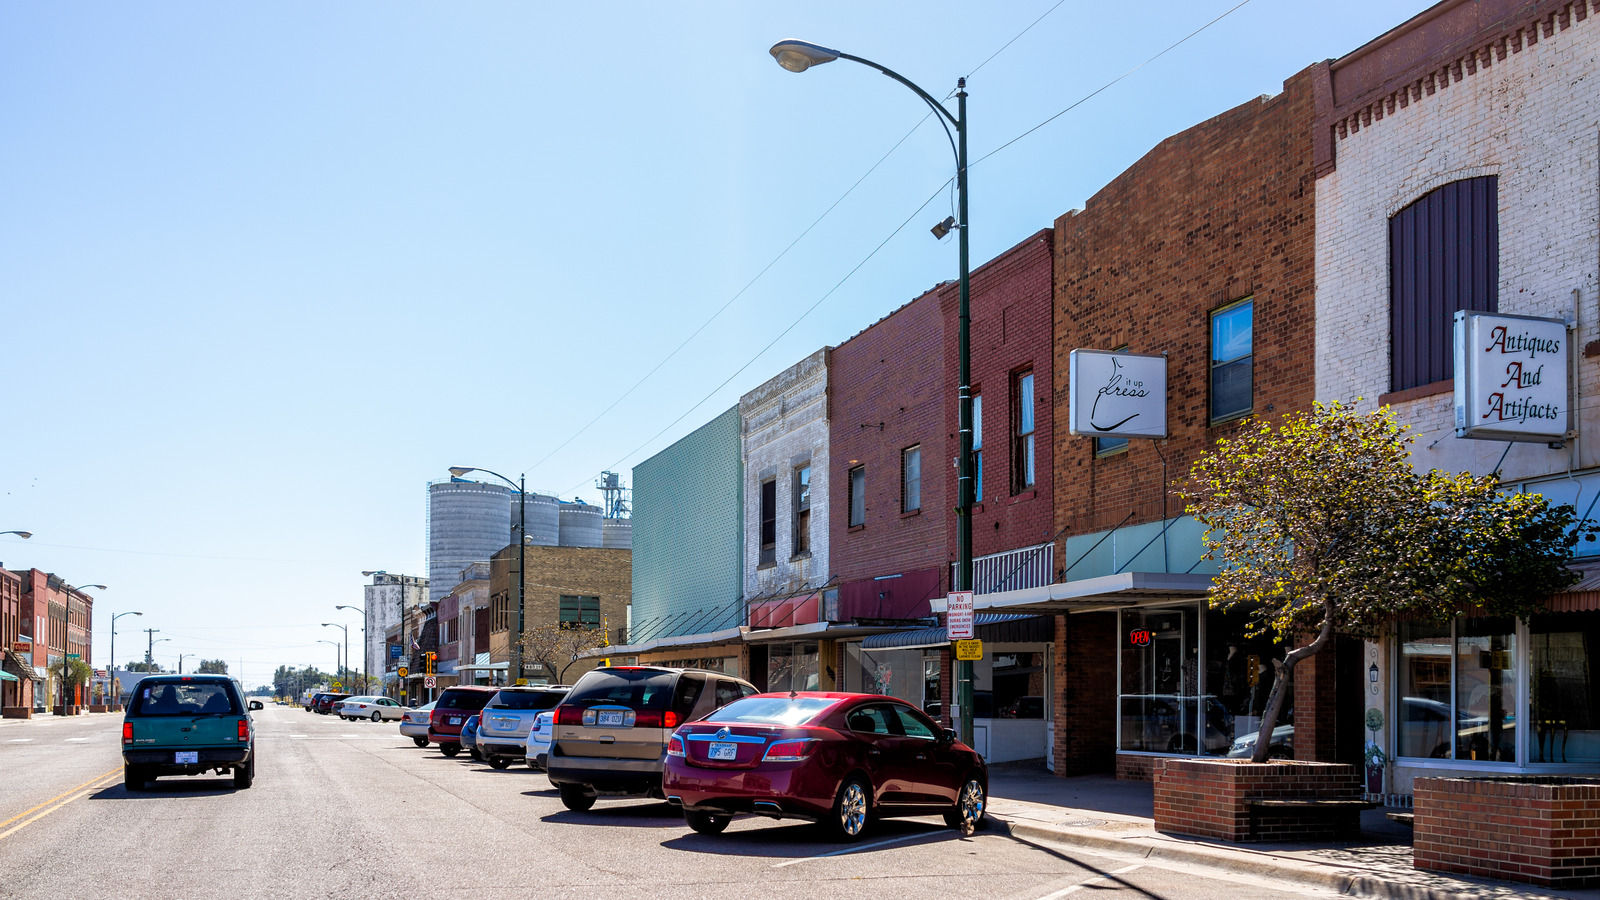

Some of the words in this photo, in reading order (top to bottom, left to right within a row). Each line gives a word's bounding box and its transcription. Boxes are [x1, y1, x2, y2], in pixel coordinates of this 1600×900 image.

[1485, 326, 1559, 358] Antiques
[1501, 361, 1544, 389] And
[1099, 375, 1150, 397] dress
[1126, 378, 1131, 386] it
[1134, 380, 1143, 388] up
[1482, 392, 1558, 424] Artifacts
[948, 603, 972, 611] PARKING
[1131, 631, 1149, 644] OPEN
[600, 715, 609, 723] 384
[711, 747, 721, 757] 795
[724, 748, 735, 757] GRF
